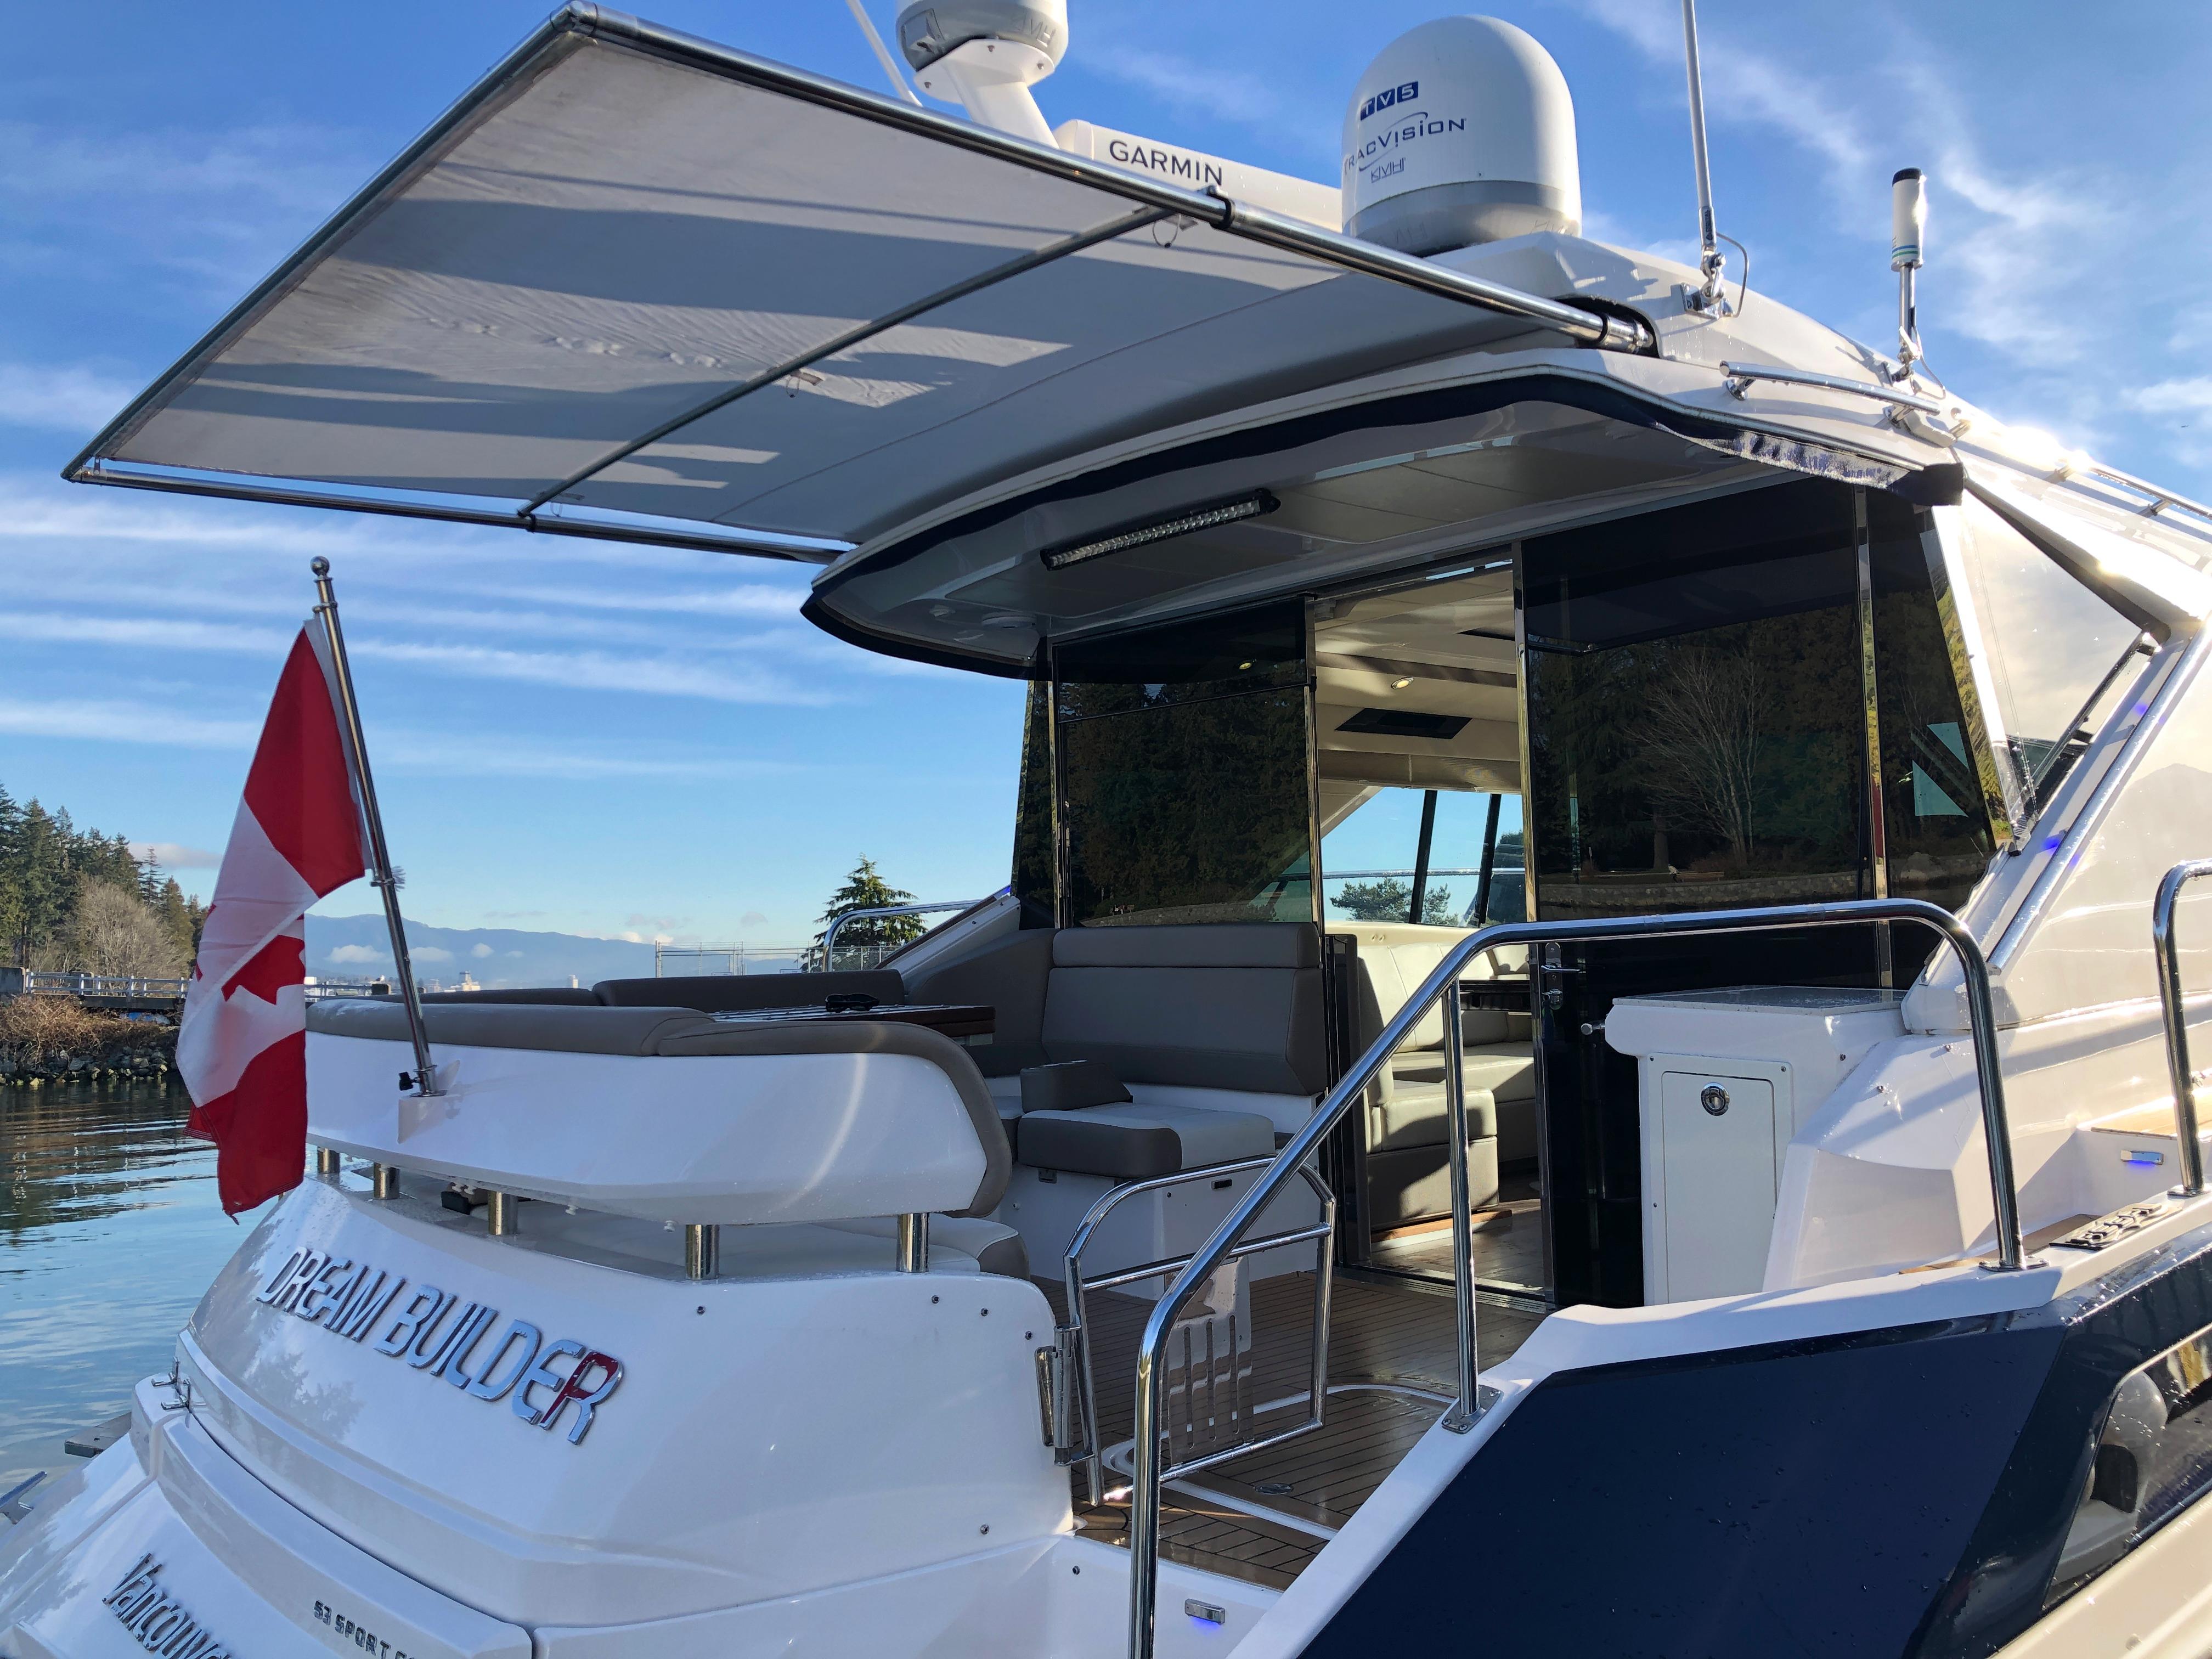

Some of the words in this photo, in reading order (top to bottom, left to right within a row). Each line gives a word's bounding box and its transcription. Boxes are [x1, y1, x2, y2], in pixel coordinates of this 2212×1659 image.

[1361, 82, 1417, 119] TV5
[1109, 140, 1223, 185] GARMIN
[1371, 157, 1404, 183] KVH
[256, 1246, 407, 1343] DREAM
[373, 1284, 624, 1445] BUILDER
[314, 1600, 332, 1626] 53
[335, 1614, 391, 1659] SPORT
